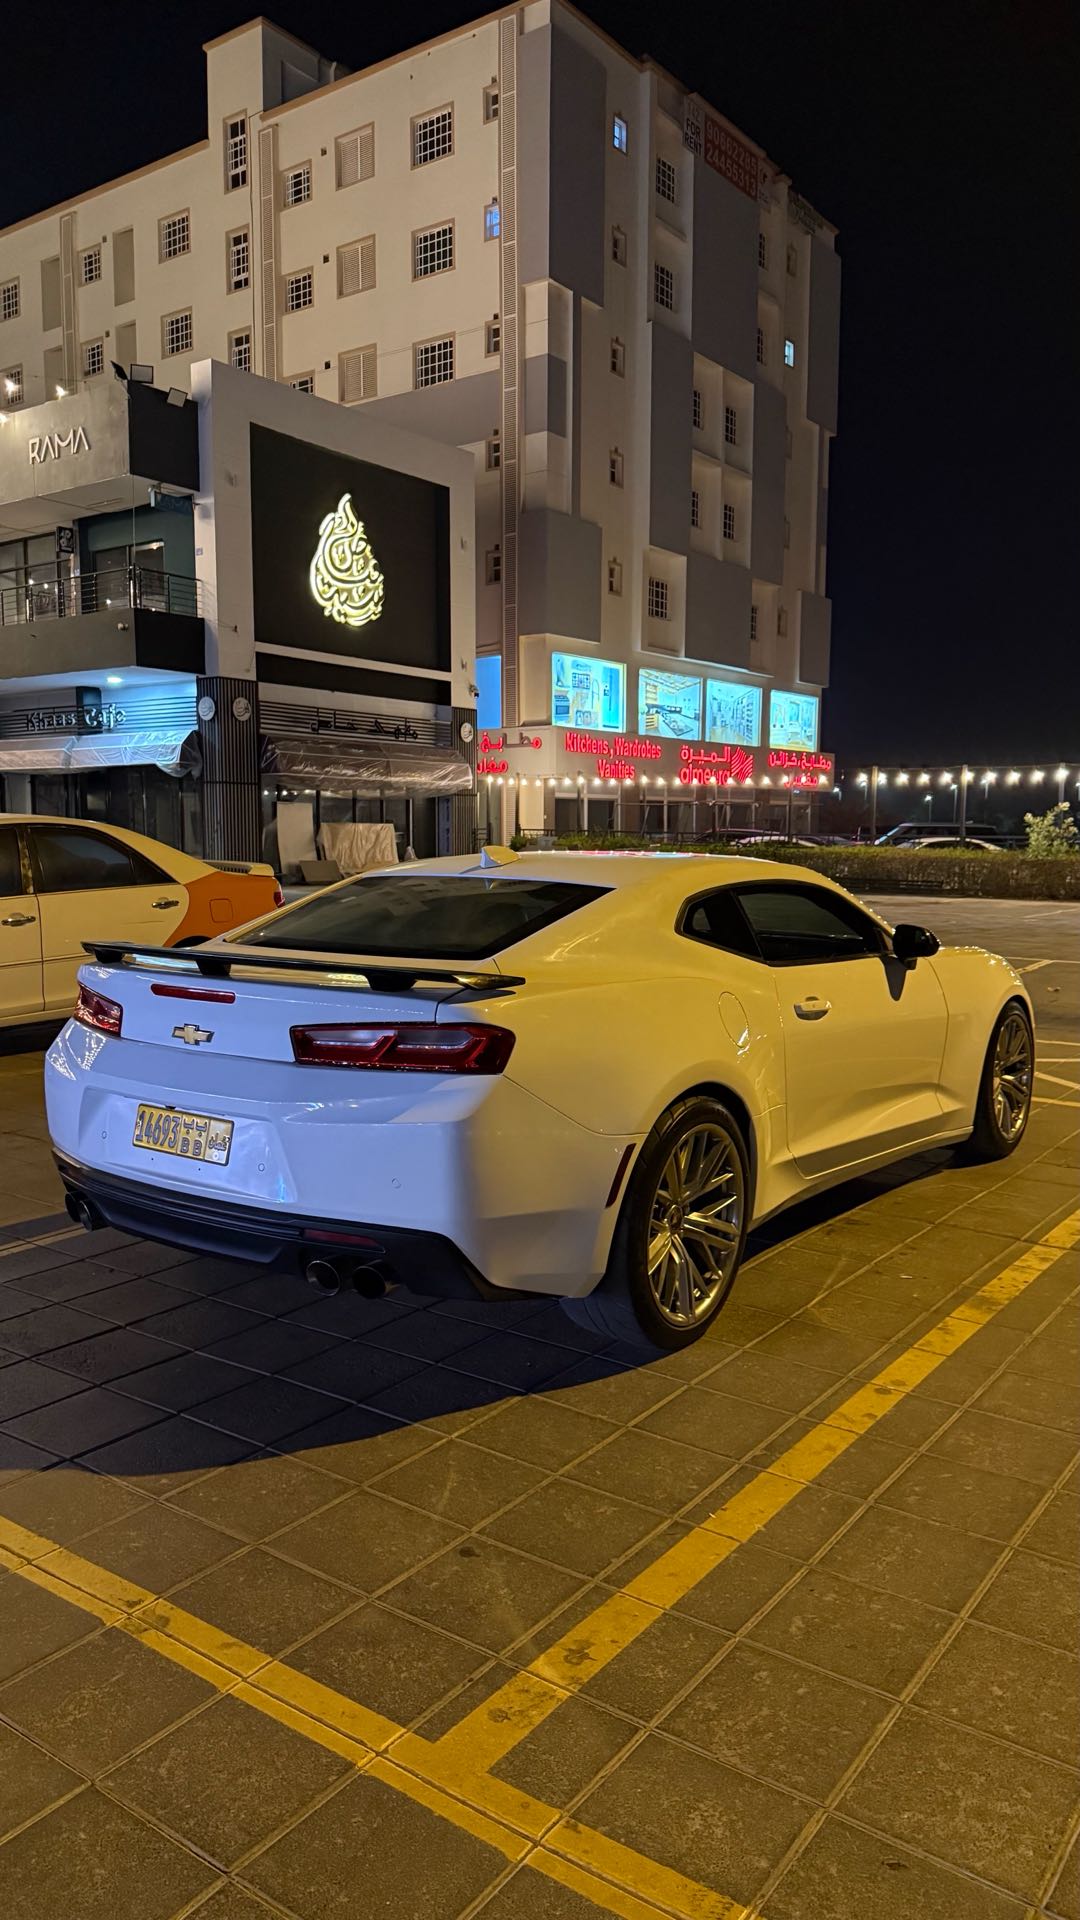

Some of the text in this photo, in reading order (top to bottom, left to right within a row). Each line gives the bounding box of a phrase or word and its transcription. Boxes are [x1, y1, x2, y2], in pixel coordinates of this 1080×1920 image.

[686, 118, 700, 140] FOR
[684, 132, 702, 156] RENT
[29, 426, 90, 465] RAMA
[615, 737, 662, 759] Wardrobes
[597, 758, 636, 780] Vanities
[135, 1110, 180, 1149] 14693
